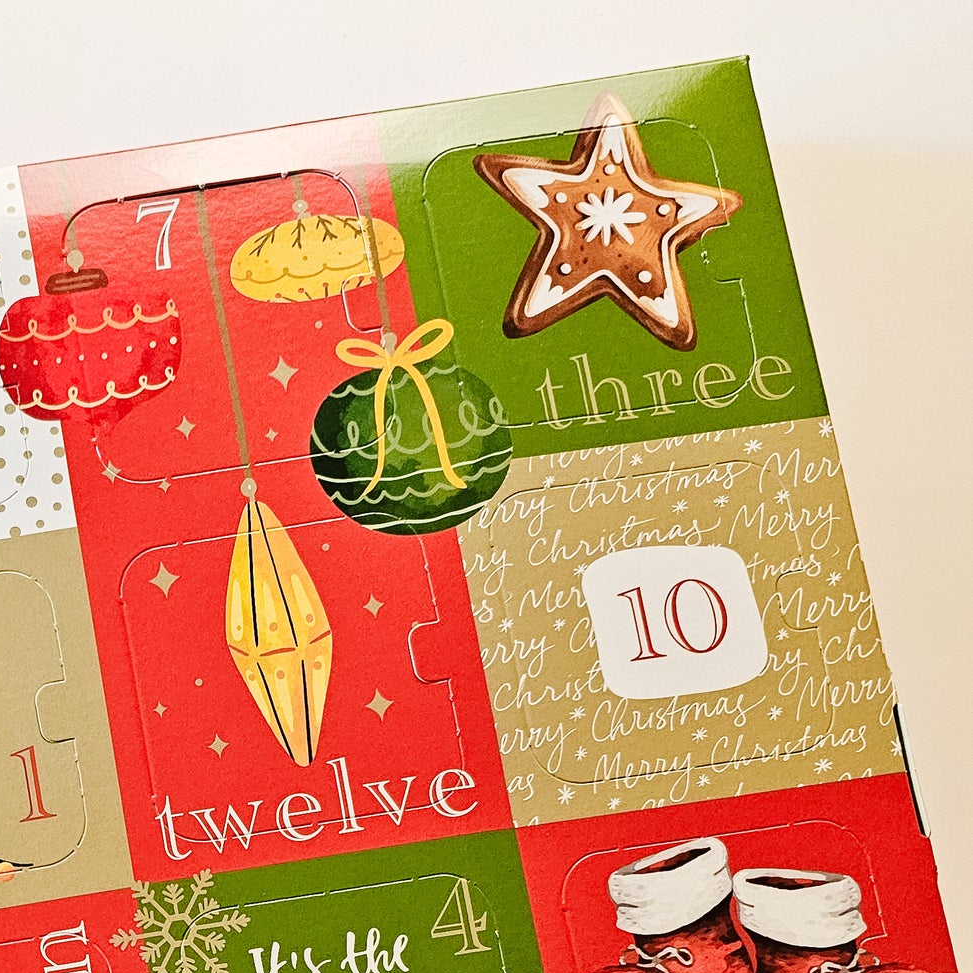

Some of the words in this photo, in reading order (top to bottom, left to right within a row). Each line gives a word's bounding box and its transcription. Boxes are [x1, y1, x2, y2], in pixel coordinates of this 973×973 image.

[136, 196, 180, 271] 7
[535, 353, 795, 430] three
[569, 461, 751, 513] Christmas
[529, 515, 721, 566] Christmas
[728, 501, 841, 550] Merry
[617, 579, 728, 662] 10
[761, 586, 876, 633] Merry
[591, 693, 767, 743] Christmas
[796, 672, 897, 727] Merry
[10, 745, 58, 823] 1
[593, 751, 693, 803] Merry
[711, 725, 867, 774] Christmas
[154, 756, 479, 861] twelve
[431, 878, 492, 956] 4
